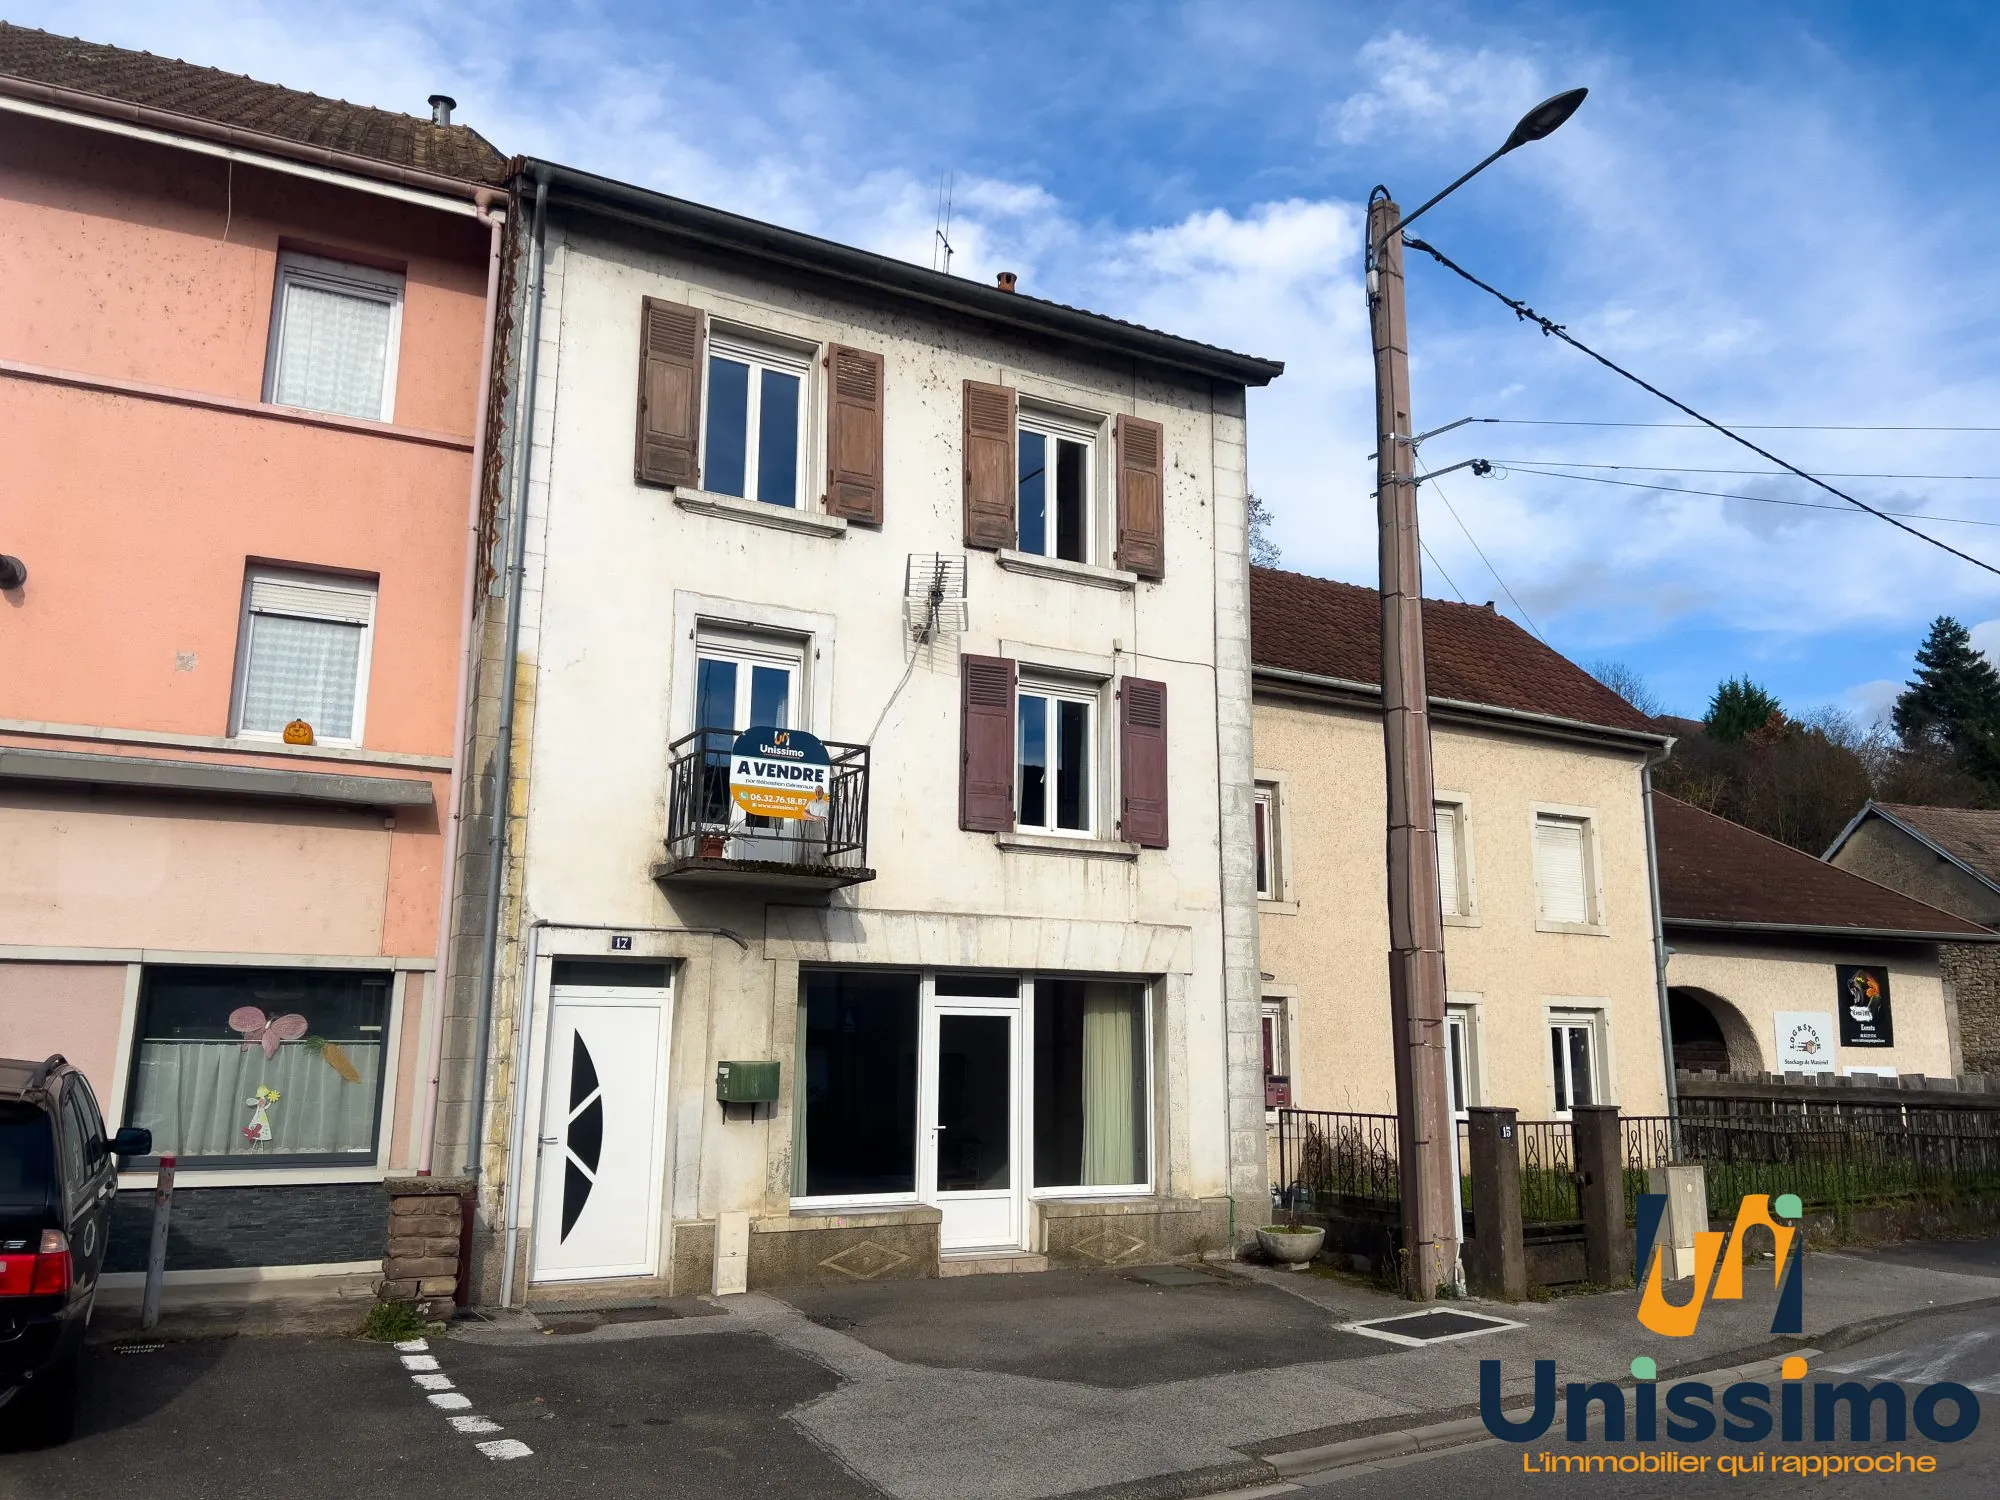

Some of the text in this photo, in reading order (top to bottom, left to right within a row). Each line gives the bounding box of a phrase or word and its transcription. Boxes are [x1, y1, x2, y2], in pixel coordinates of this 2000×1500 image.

[760, 744, 804, 757] Unissimo
[737, 760, 824, 783] A VENDRE
[750, 793, 808, 806] 06.32.76.18.87
[615, 937, 629, 949] 17
[1502, 1126, 1512, 1138] 15
